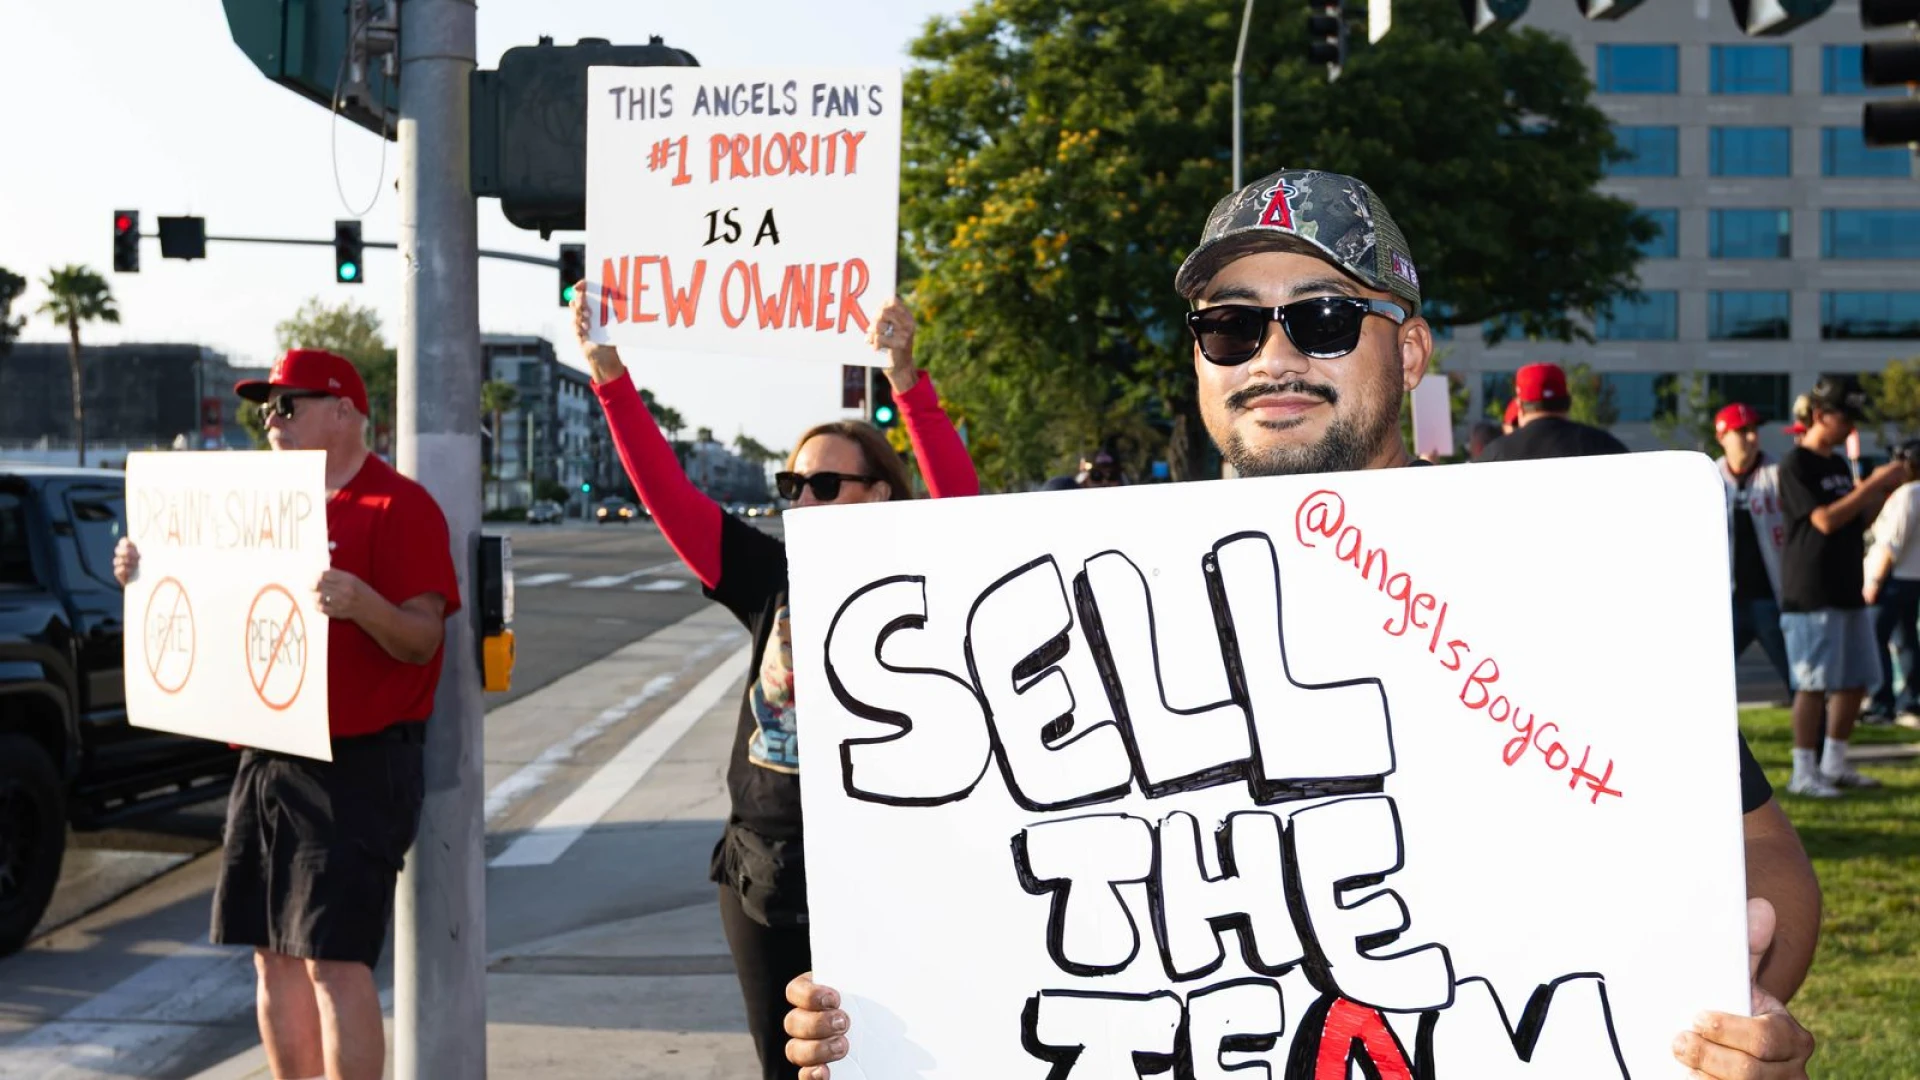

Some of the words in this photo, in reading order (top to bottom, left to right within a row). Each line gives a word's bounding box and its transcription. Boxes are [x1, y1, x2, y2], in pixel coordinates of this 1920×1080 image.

[609, 84, 673, 120] THIS
[692, 80, 797, 117] ANGELS
[811, 83, 883, 118] FAN'S
[646, 135, 692, 186] #1
[710, 128, 867, 184] PRIORITY
[702, 207, 742, 247] IS
[753, 208, 780, 247] A
[600, 256, 707, 328] NEW
[719, 258, 871, 334] OWNER
[137, 487, 202, 548] DRAIN
[225, 488, 312, 551] SWAMP
[250, 619, 304, 666] PERRY
[824, 530, 1396, 811] SELL
[1295, 489, 1622, 804] @angelsBoycott
[1010, 794, 1455, 1013] THE
[1021, 972, 1630, 1080] TEAM
